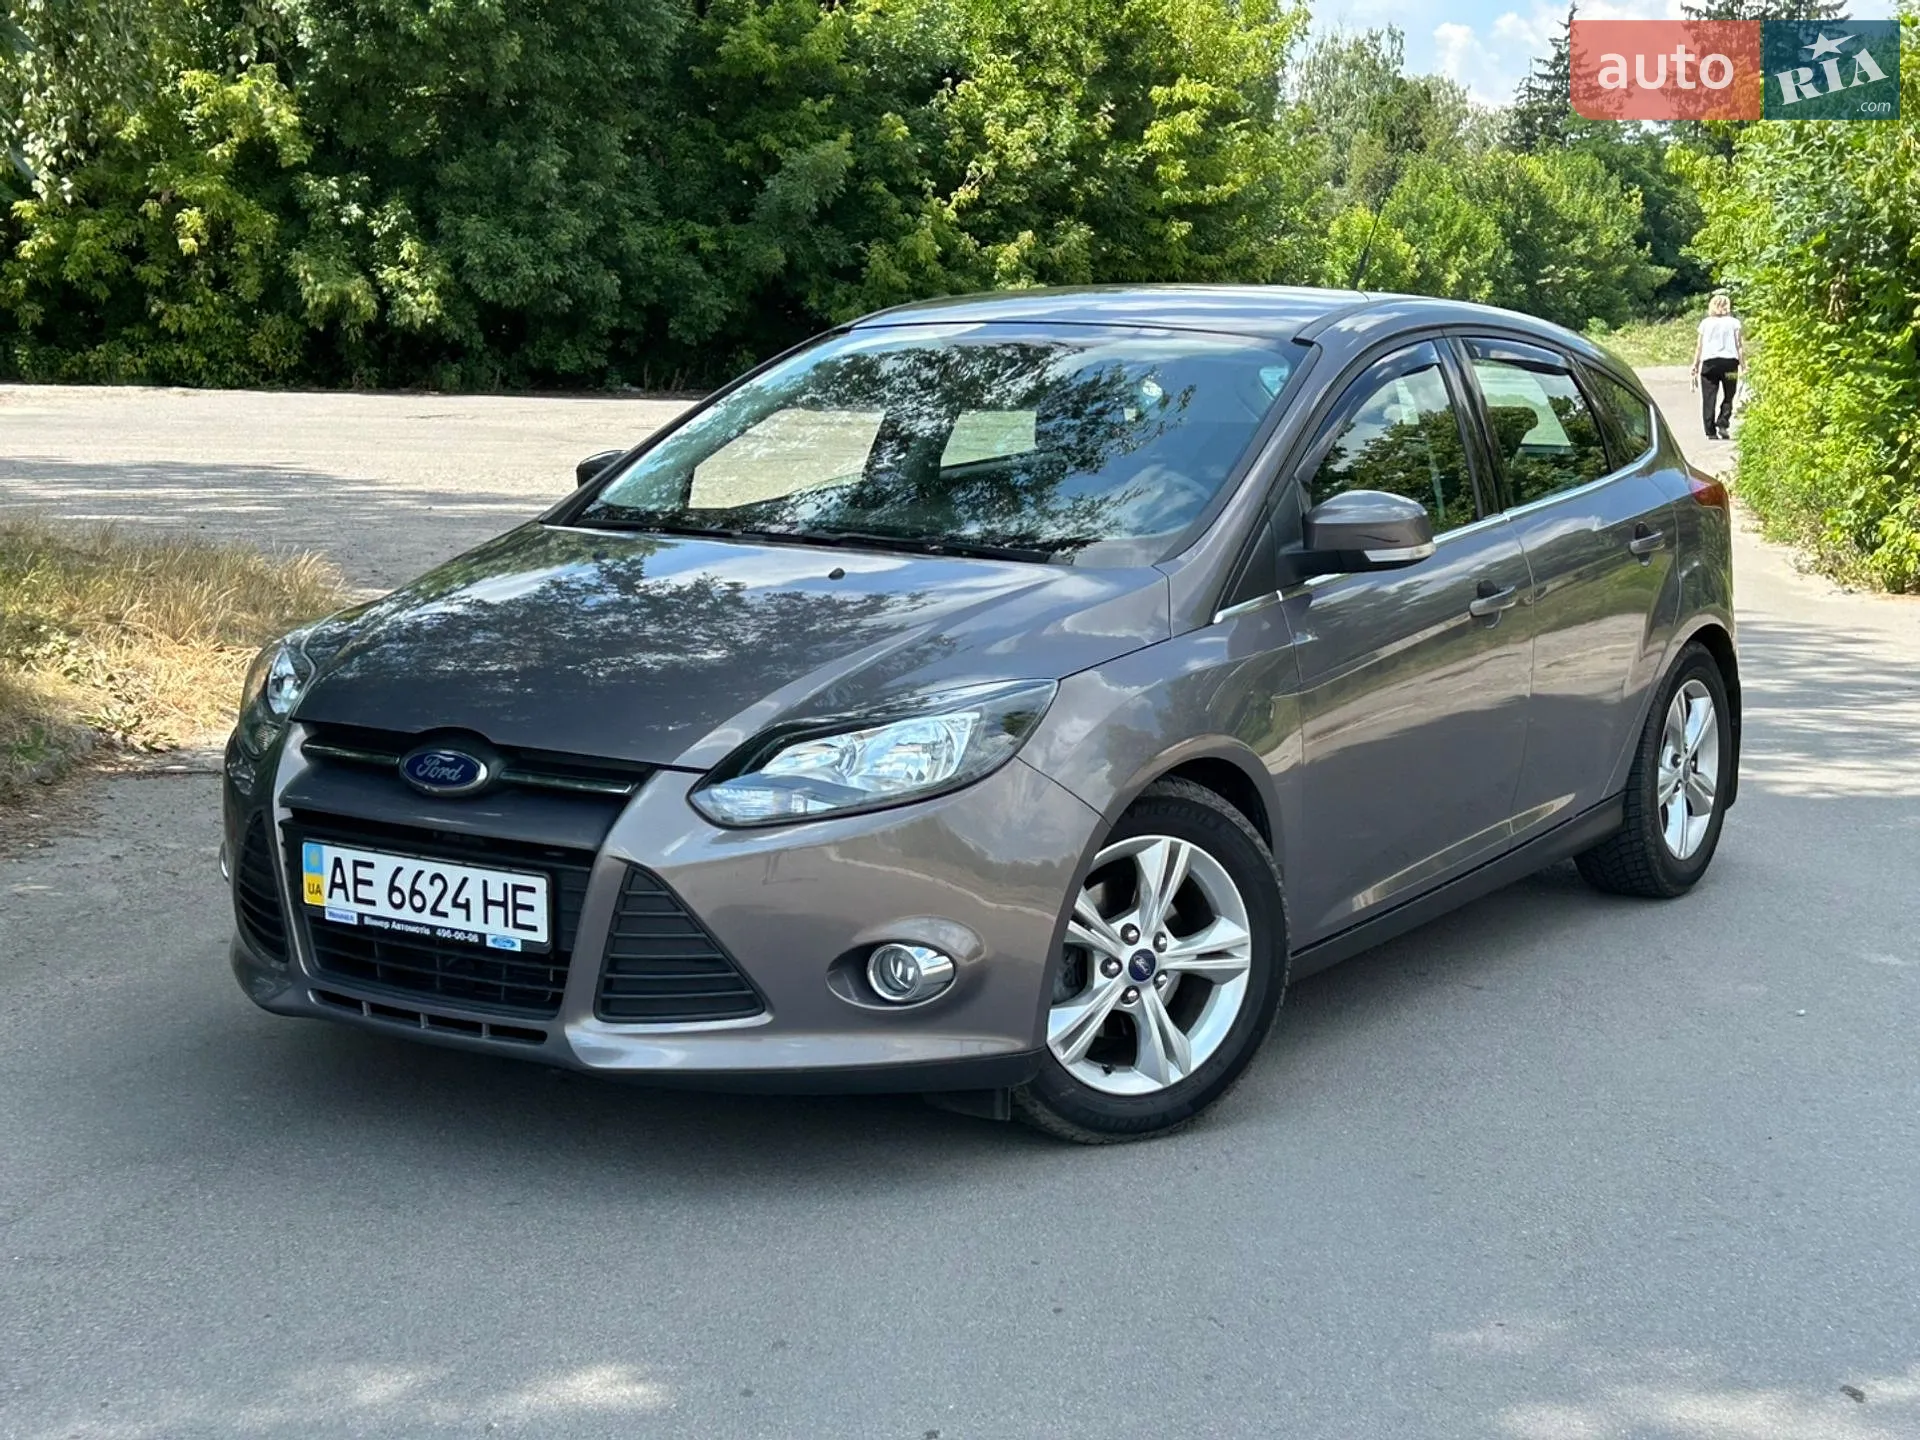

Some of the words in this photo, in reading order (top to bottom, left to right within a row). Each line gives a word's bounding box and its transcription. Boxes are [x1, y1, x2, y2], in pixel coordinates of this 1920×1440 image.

[415, 753, 465, 782] Ford
[307, 882, 323, 897] UA
[328, 857, 377, 906] AE
[387, 866, 472, 923] 6624
[482, 879, 538, 933] HE
